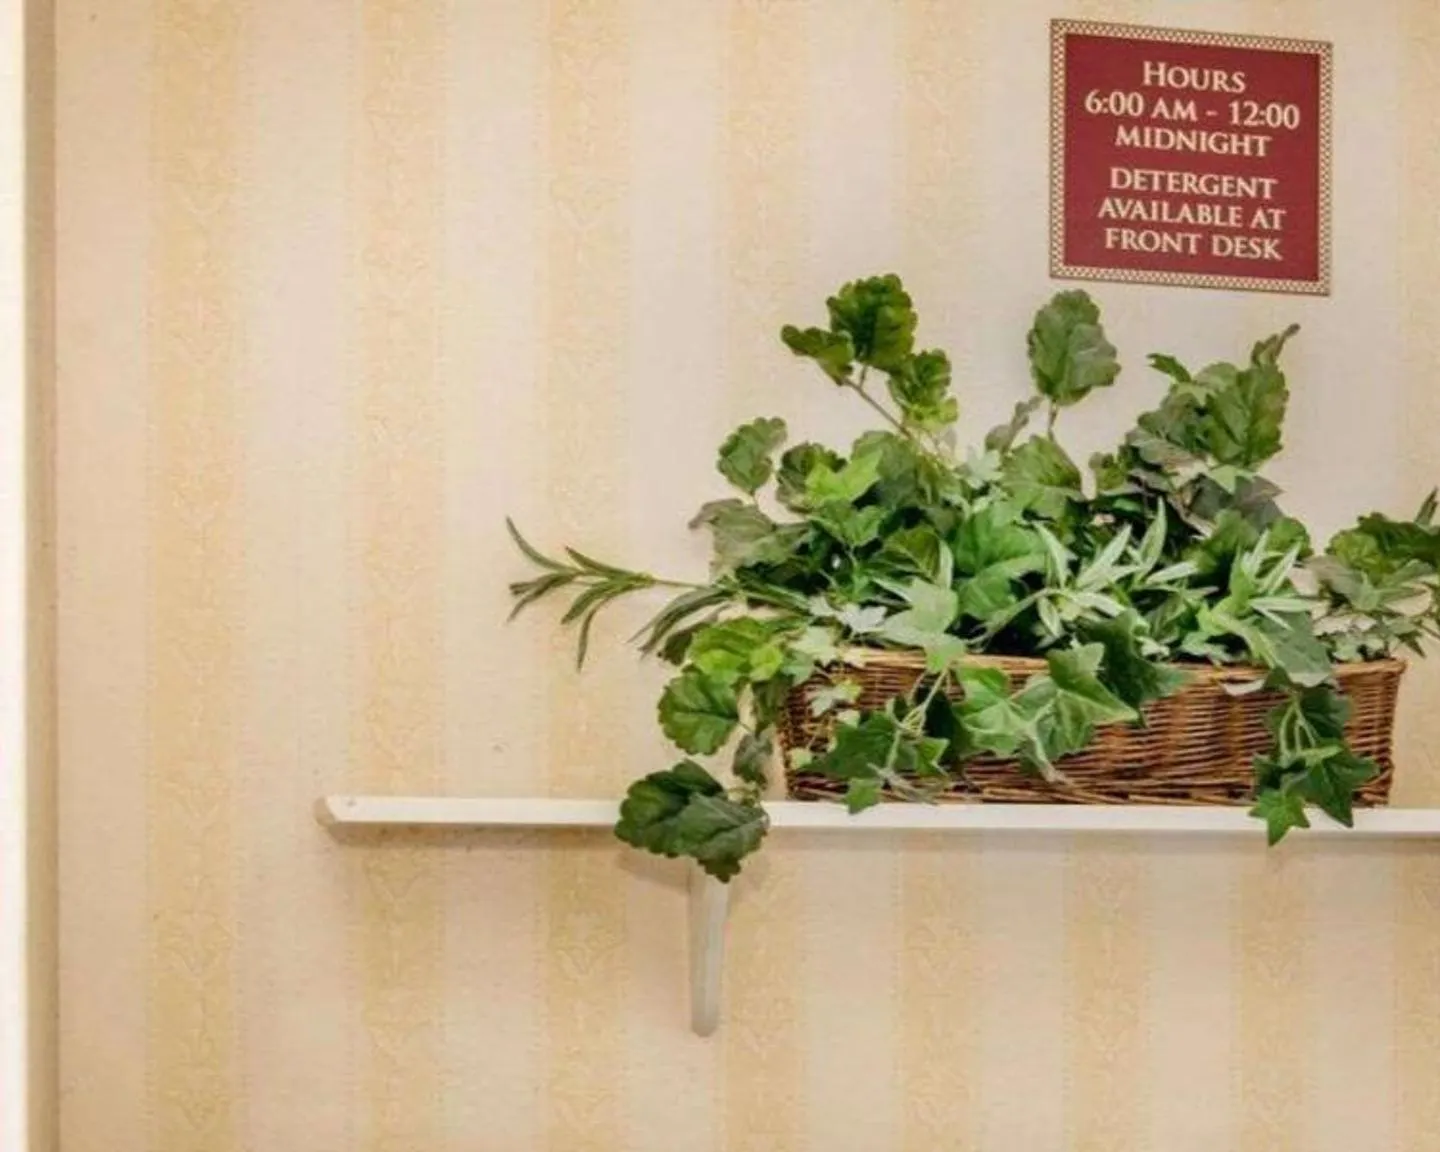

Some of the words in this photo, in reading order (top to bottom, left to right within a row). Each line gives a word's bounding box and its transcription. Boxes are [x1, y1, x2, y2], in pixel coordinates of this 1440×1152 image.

[1142, 60, 1246, 93] HOURS
[1084, 90, 1145, 117] 6:00
[1151, 97, 1198, 122] AM
[1228, 100, 1300, 130] 12:00
[1115, 125, 1273, 157] MIDNIGHT
[1110, 167, 1278, 200] DETERGENT
[1097, 197, 1244, 228] AVAILABLE
[1250, 207, 1287, 231] AT
[1105, 227, 1203, 255] FRONT
[1212, 234, 1283, 261] DESK
